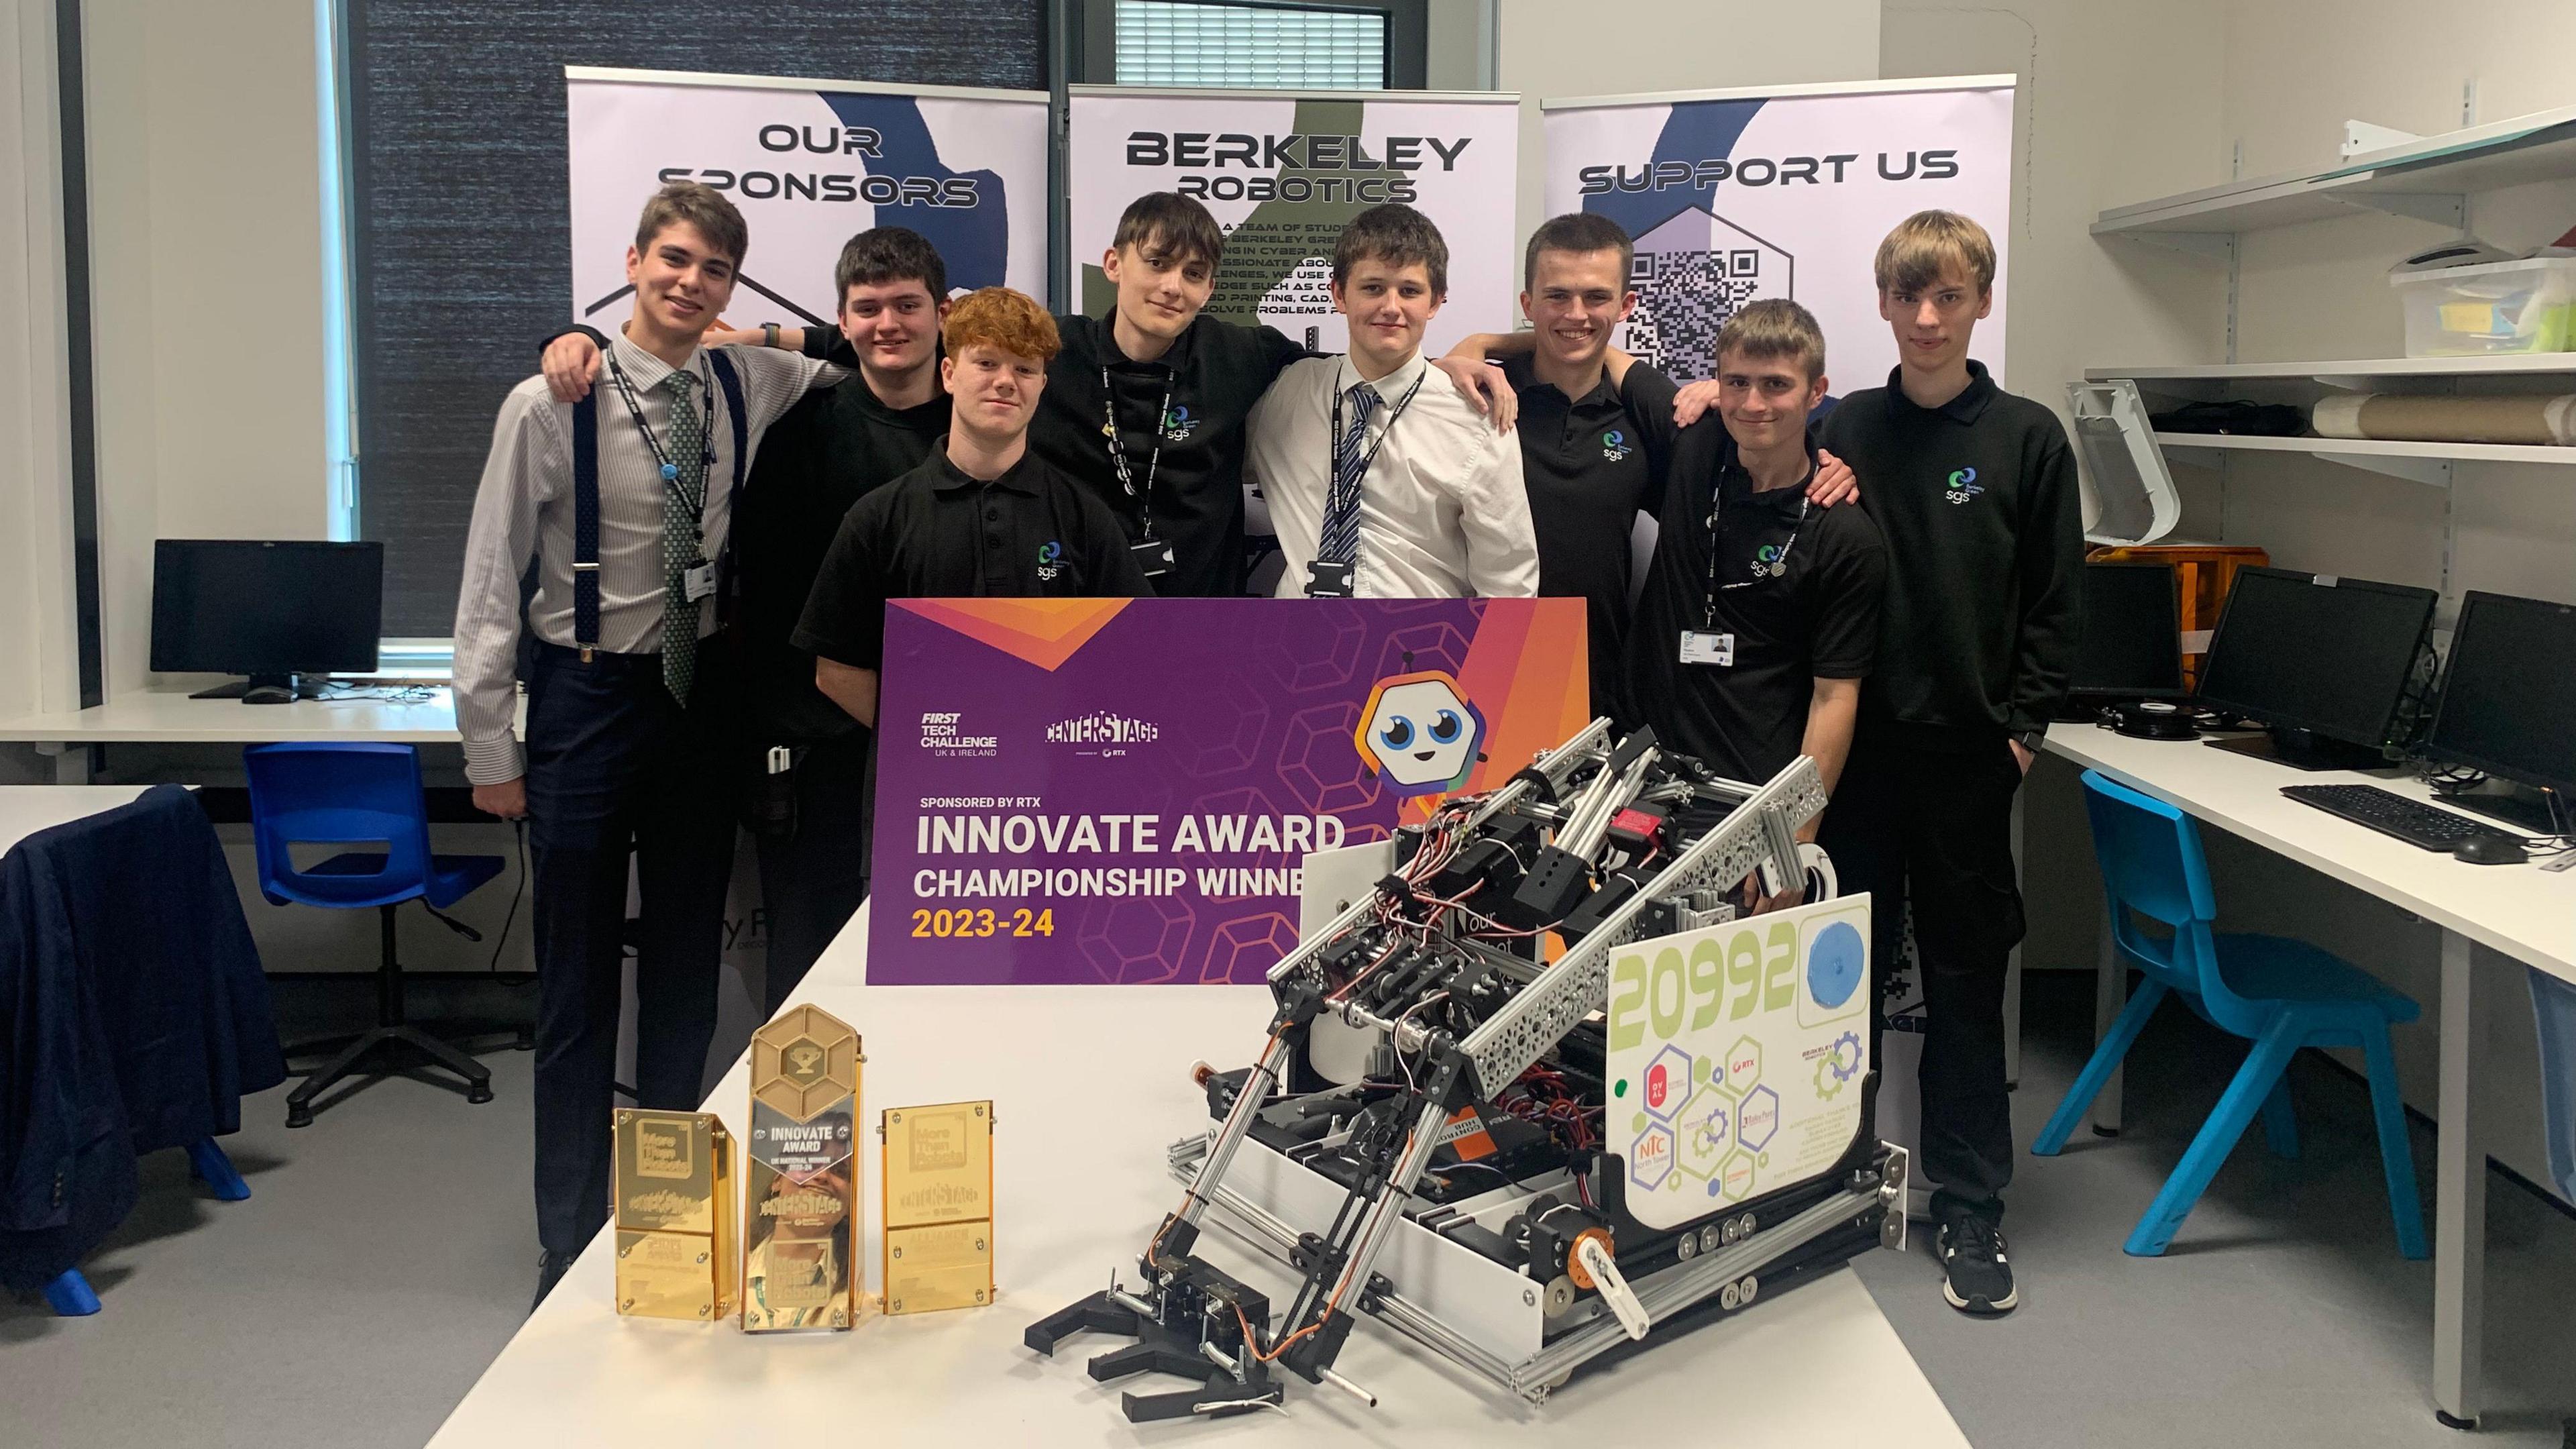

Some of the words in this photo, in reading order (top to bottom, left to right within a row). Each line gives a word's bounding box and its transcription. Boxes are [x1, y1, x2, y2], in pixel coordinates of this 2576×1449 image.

[759, 124, 883, 158] OUR
[1127, 131, 1472, 171] BERKELEY
[1578, 154, 1860, 195] SUPPORT
[1877, 150, 1959, 180] US
[1178, 176, 1417, 203] ROBOTICS
[1238, 223, 1278, 231] TEAM
[1232, 235, 1303, 244] BERKELEY
[1244, 247, 1256, 255] IN
[1260, 248, 1307, 256] CYBER
[1220, 258, 1290, 266] SSIONATE
[1295, 259, 1335, 267] ABOU
[1272, 271, 1293, 279] WE
[1297, 271, 1324, 279] USE
[1251, 282, 1289, 290] SUCH
[1230, 294, 1296, 303] PRINTING,
[1300, 295, 1332, 303] CAD,
[1249, 306, 1326, 314] PROBLEMS
[1167, 429, 1190, 441] sgs
[1603, 449, 1623, 462] sgs
[1946, 490, 1970, 504] sgs
[1037, 566, 1057, 581] sgs
[922, 713, 961, 724] FIRST
[921, 725, 957, 736] TECH
[920, 737, 998, 747] CHALLENGE
[920, 797, 995, 808] SPONSORED
[998, 797, 1014, 808] BY
[1016, 797, 1040, 808] RTX
[917, 815, 1159, 853] INNOVATE
[1171, 815, 1346, 853] AWARD
[914, 869, 1186, 898] CHAMPIONSHIP
[1197, 868, 1303, 896] WINNE
[912, 909, 1055, 937] 2023-24
[1611, 920, 1797, 1053] 20992
[1802, 1043, 1833, 1058] BERKELEY
[1741, 1059, 1755, 1069] RTX
[1454, 1120, 1476, 1130] HUB
[771, 1126, 833, 1140] INNOVATE
[782, 1141, 821, 1153] AWARD
[1640, 1134, 1665, 1159] NTC
